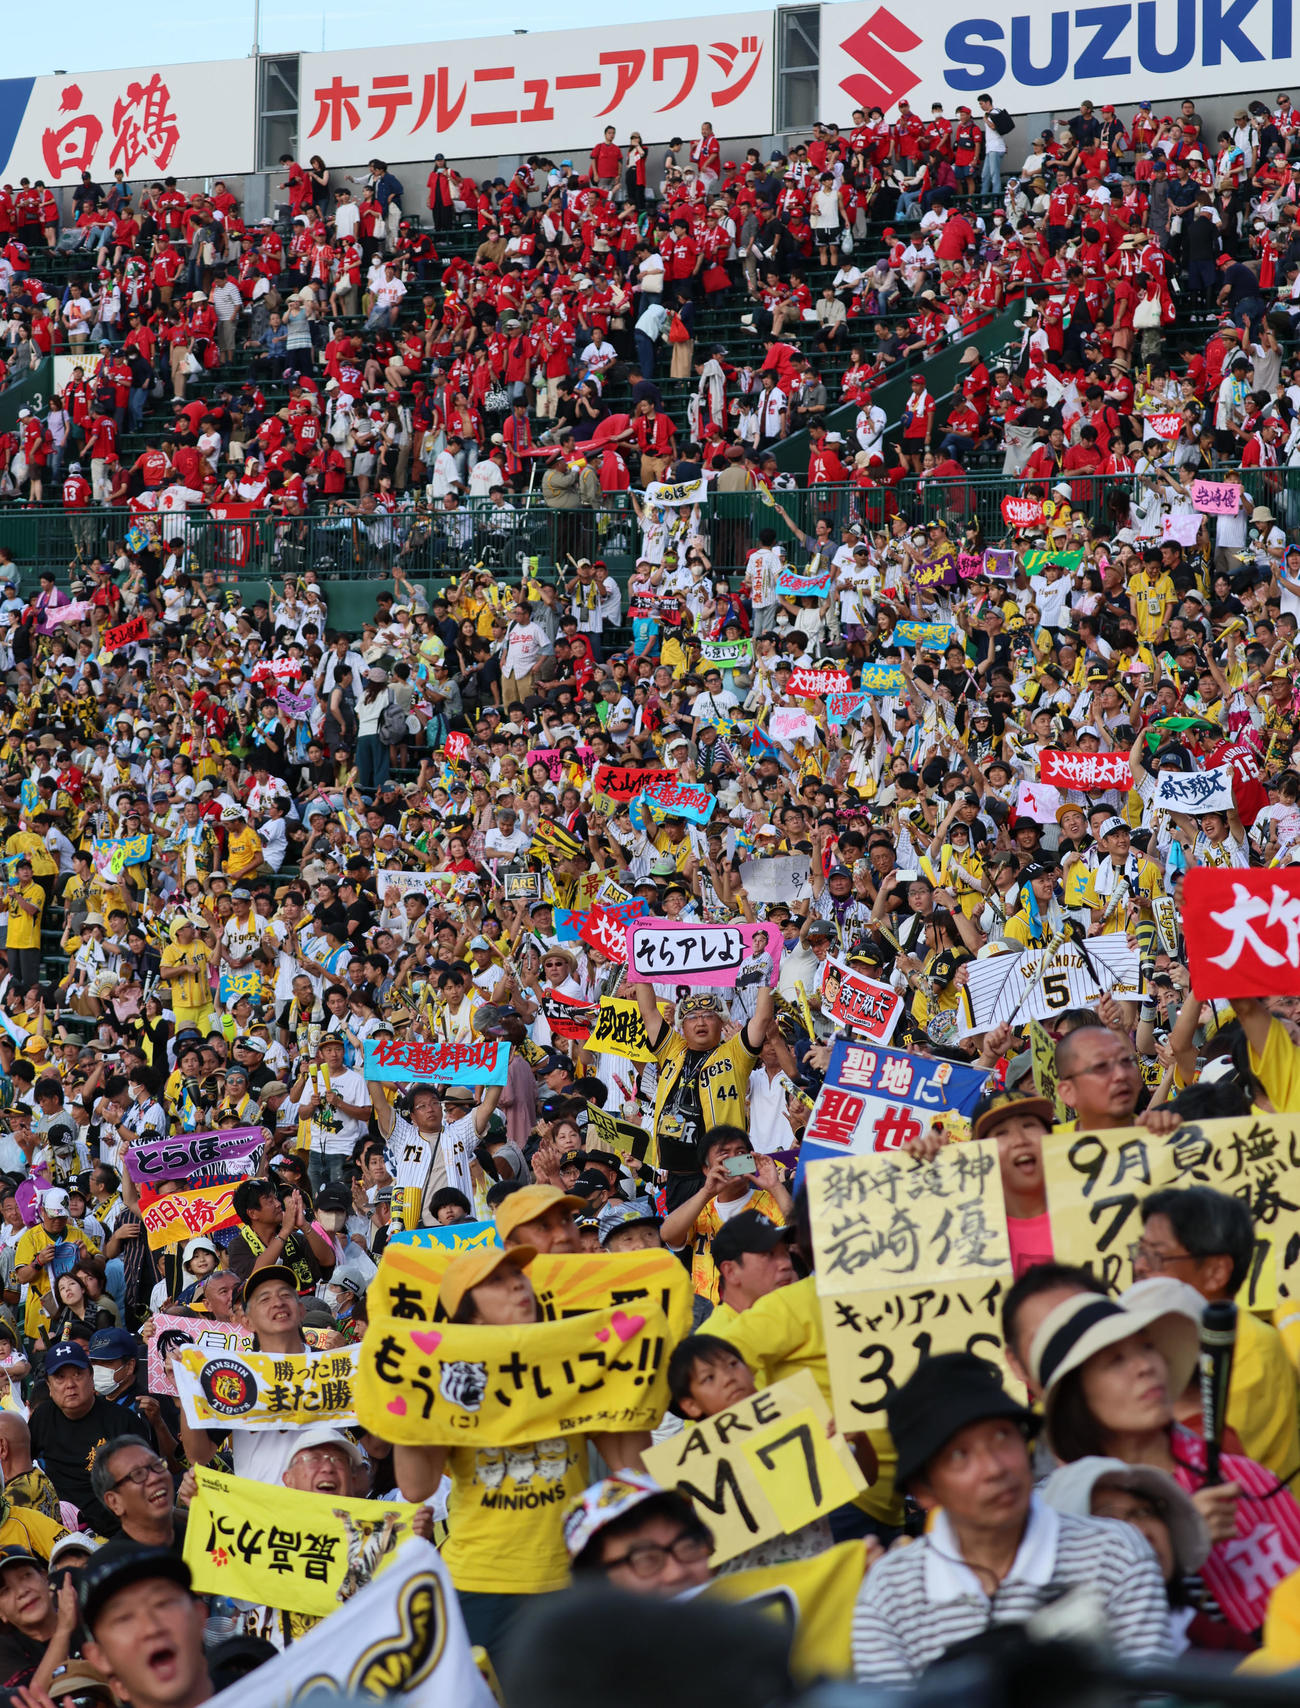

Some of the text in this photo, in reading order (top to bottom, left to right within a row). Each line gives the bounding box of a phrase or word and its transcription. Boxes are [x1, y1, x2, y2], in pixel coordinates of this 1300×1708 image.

[943, 0, 1292, 91] SUZUKI
[307, 36, 764, 142] ホテルニューアワジ
[41, 73, 181, 180] 白鶴
[341, 371, 358, 384] 27
[301, 426, 316, 439] 60
[64, 487, 77, 501] 13
[1195, 487, 1236, 509] 岩崎優
[1047, 752, 1133, 784] 大竹耕太郎
[1159, 768, 1227, 801] 森下翔太
[1233, 753, 1260, 783] 15
[511, 877, 535, 891] ARE
[636, 931, 735, 968] そらアレよ
[840, 983, 890, 1024] 森下翔太
[1043, 972, 1070, 1010] 5
[372, 1040, 499, 1075] 佐藤輝明
[838, 1045, 940, 1104] 聖地に
[716, 1084, 739, 1102] 44
[806, 1088, 923, 1153] 聖也
[136, 1135, 221, 1174] とらほ
[823, 1197, 1010, 1275] 岩崎優
[205, 1361, 249, 1378] HANSHIN
[211, 1398, 251, 1415] Tigers
[676, 1392, 782, 1467] ARE
[480, 1484, 566, 1510] MINIONS
